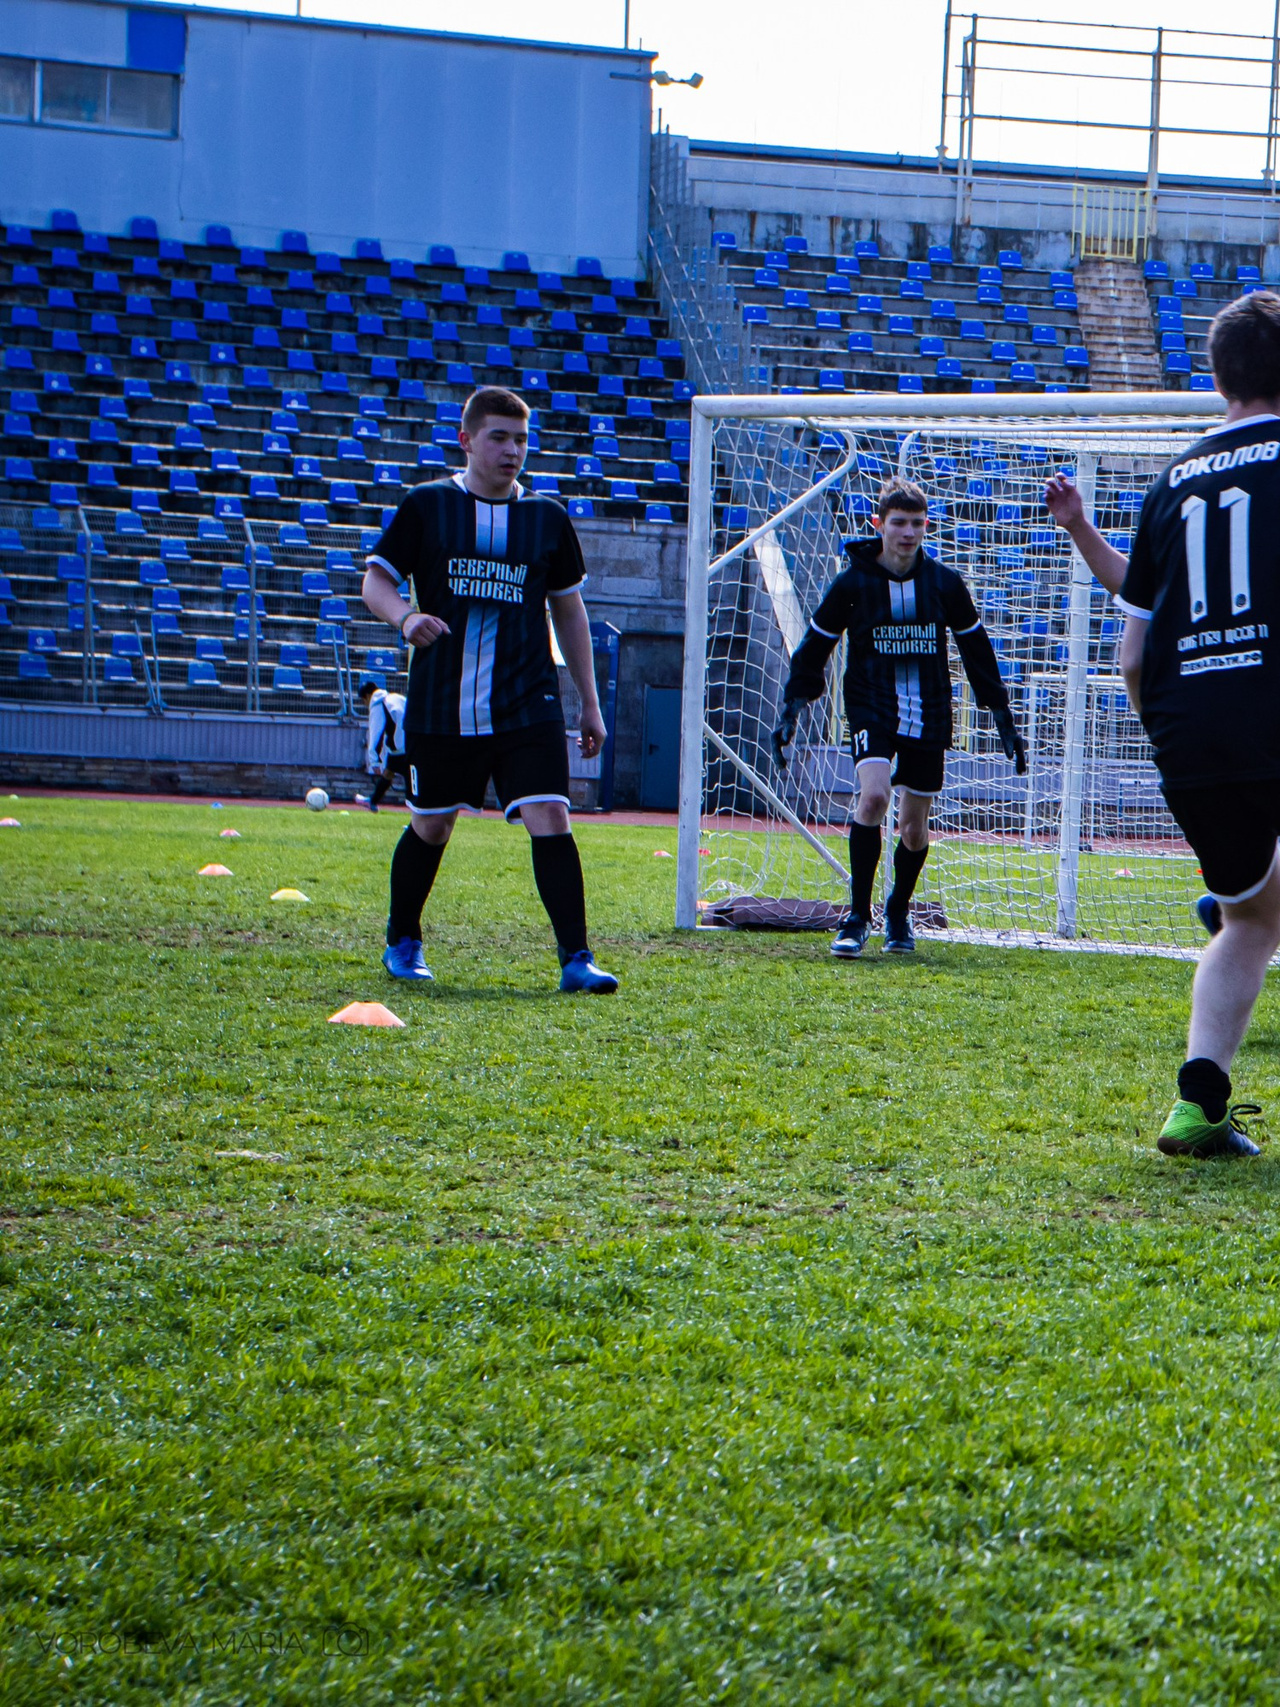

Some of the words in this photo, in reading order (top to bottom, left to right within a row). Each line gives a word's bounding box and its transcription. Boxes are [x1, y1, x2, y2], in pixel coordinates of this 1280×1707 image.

[1180, 486, 1252, 624] 11
[448, 557, 528, 586] СЕВЕРНЫЙ
[448, 578, 524, 604] ЧЕЛОВЕК
[872, 622, 937, 640] СЕВЕРНЫЙ
[873, 639, 937, 655] ЧЕЛОВЕК
